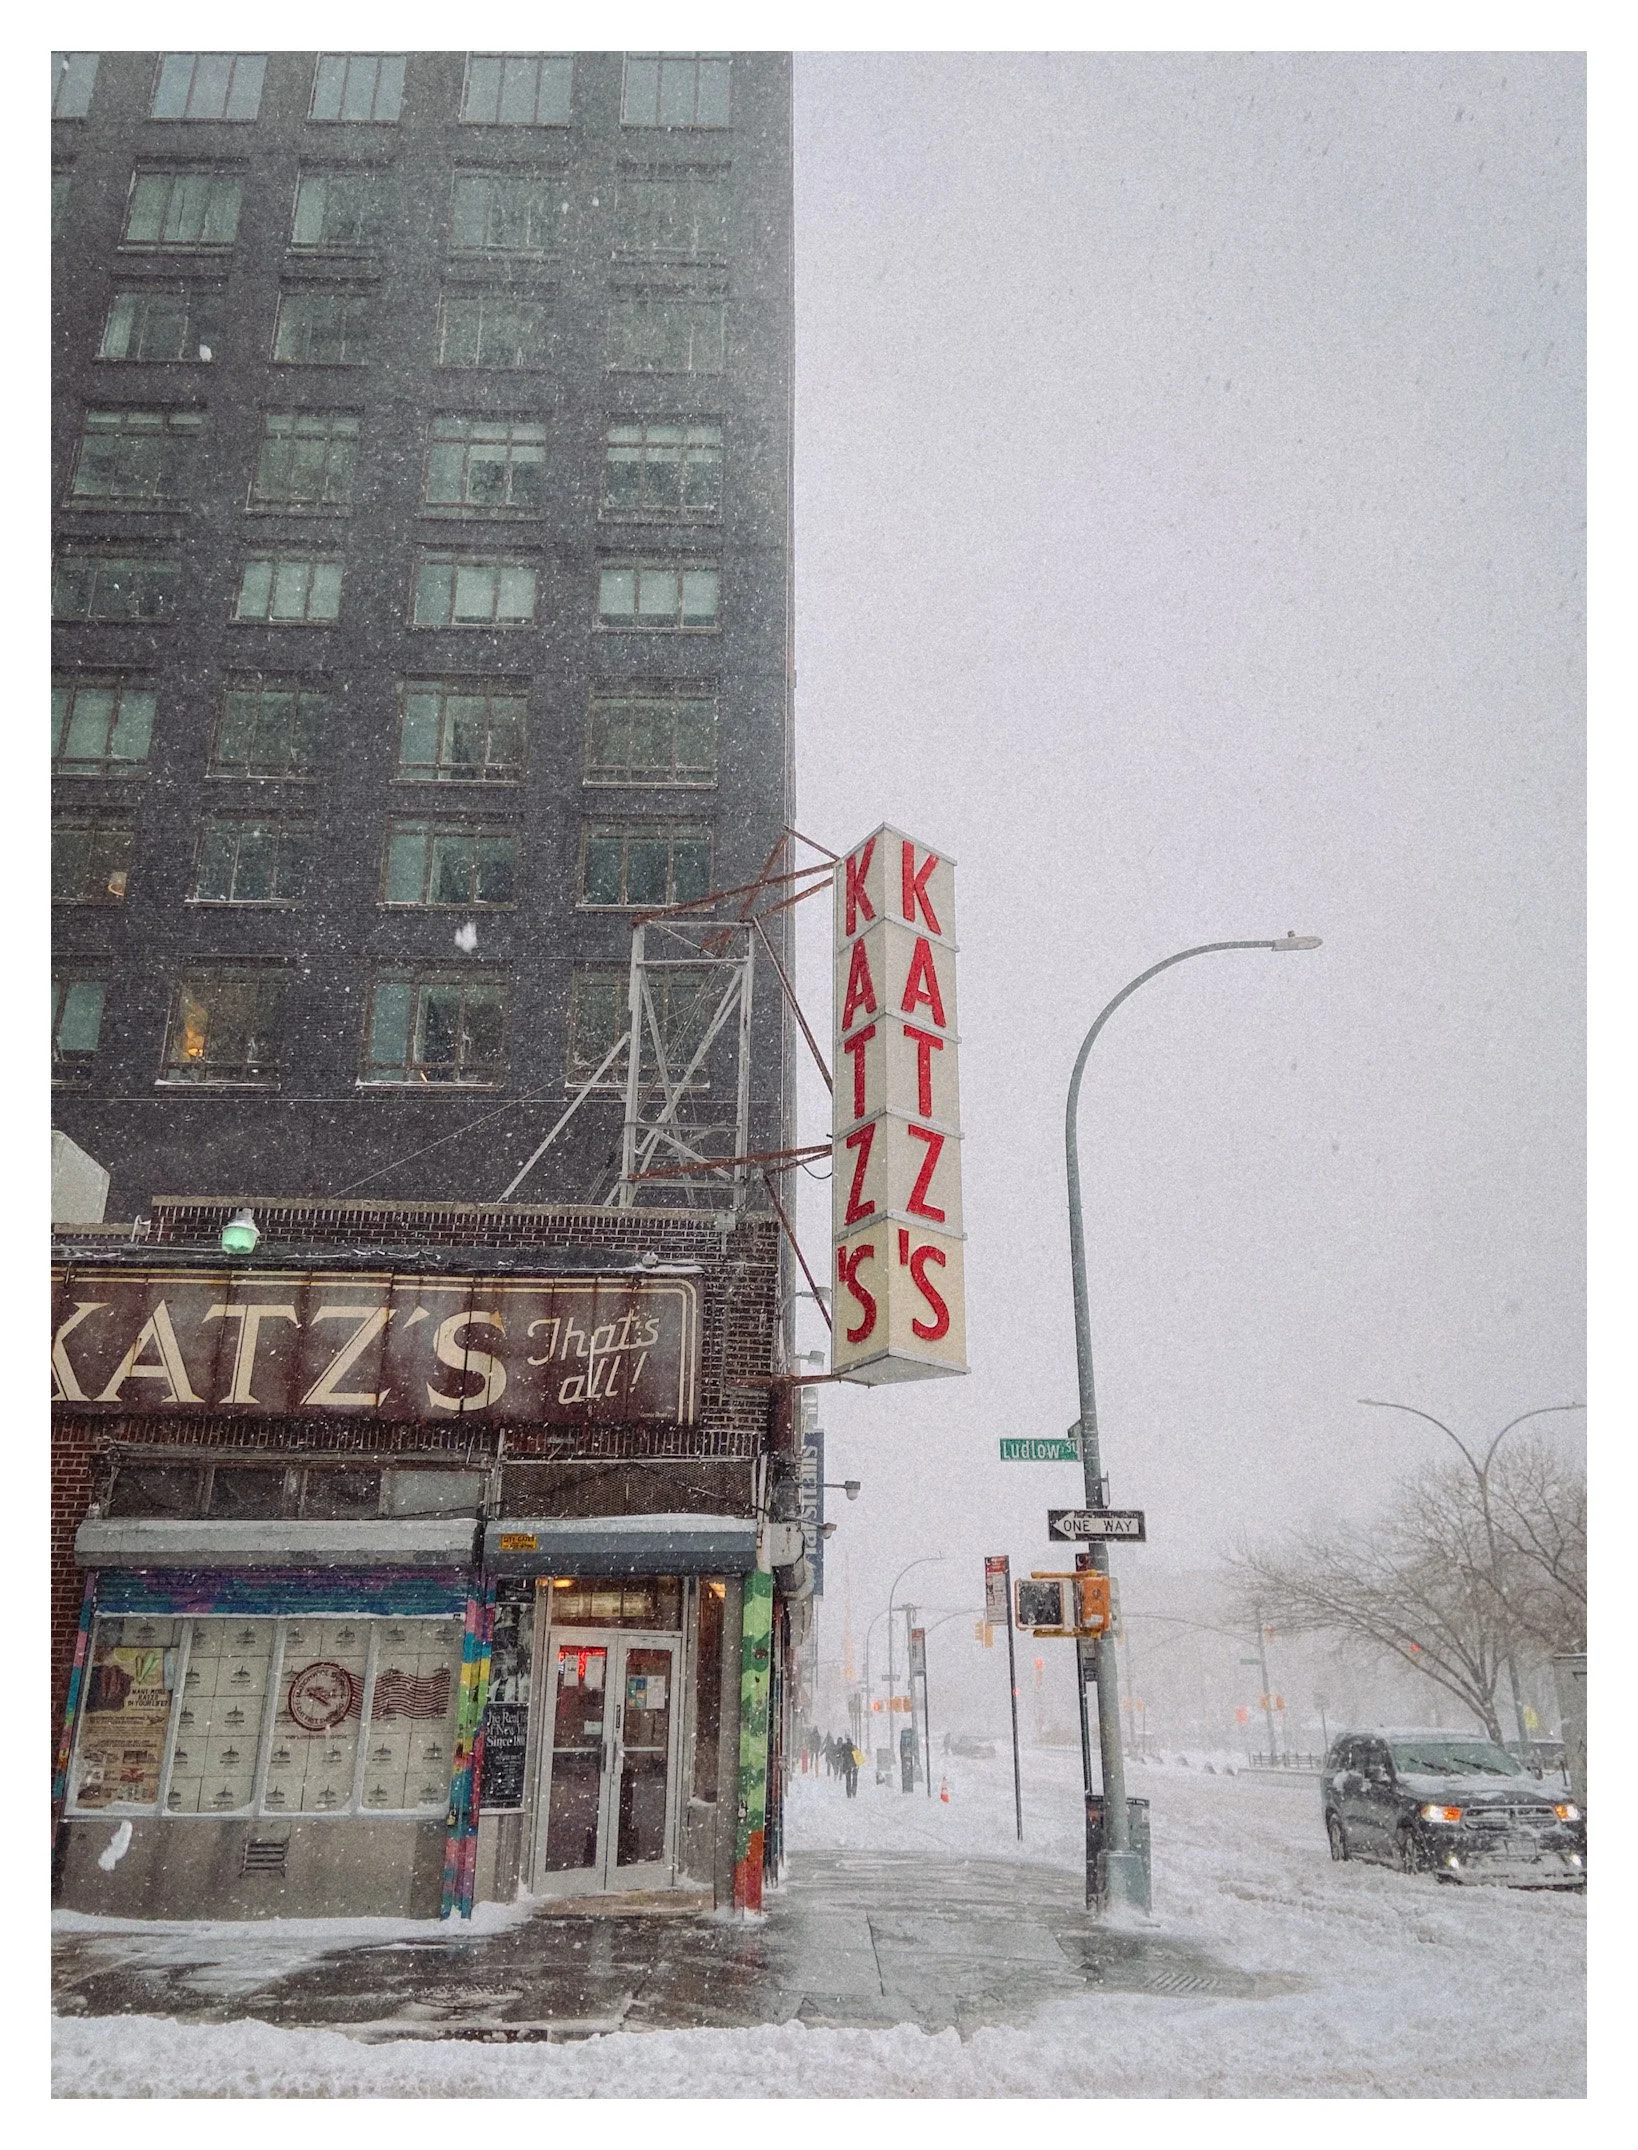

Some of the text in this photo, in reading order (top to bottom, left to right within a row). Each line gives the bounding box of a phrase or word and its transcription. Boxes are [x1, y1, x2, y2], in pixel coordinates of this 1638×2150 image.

[836, 837, 878, 1344] KATZ'S
[897, 839, 950, 1342] KATZ'S
[527, 1309, 660, 1365] That's
[1002, 1440, 1060, 1459] Ludlow
[1063, 1519, 1132, 1533] ONE WAY
[486, 1735, 511, 1748] Since
